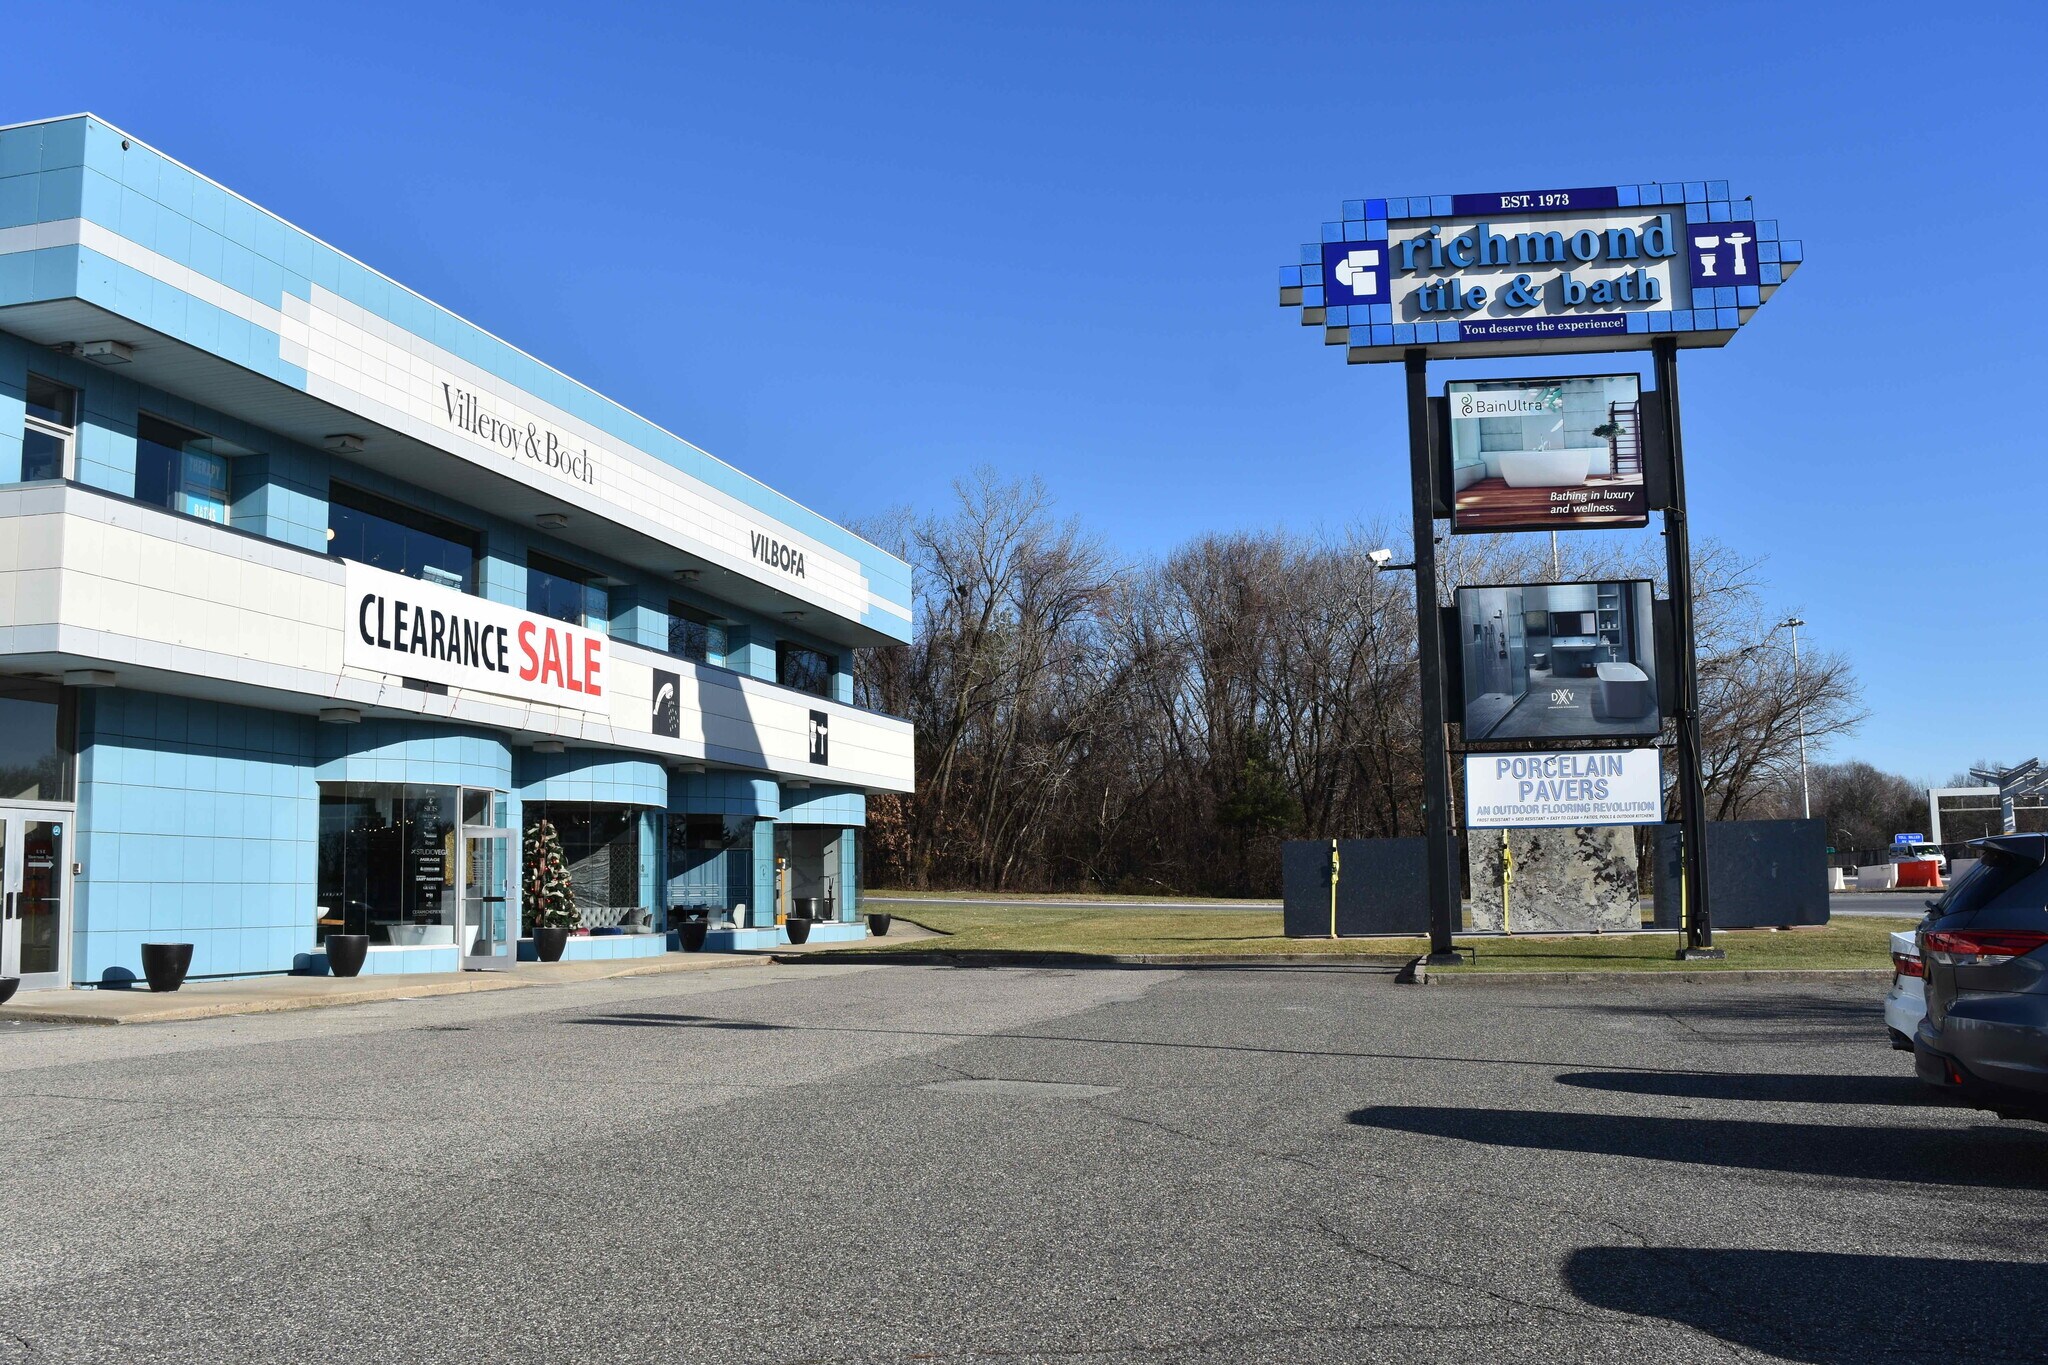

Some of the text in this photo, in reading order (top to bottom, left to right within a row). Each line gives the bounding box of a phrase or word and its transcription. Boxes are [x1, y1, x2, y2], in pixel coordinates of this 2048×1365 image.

[1500, 193, 1569, 208] EST. 1973
[1399, 213, 1677, 270] richmond
[1416, 269, 1662, 312] tile & bath
[1463, 318, 1624, 335] You deserve the experience!
[1476, 399, 1543, 413] BainUltra
[1550, 489, 1635, 503] Bathing in luxury
[1550, 502, 1617, 514] and wellness.
[750, 529, 805, 579] VILBOFA
[359, 593, 602, 697] CLEARANCE SALE
[1551, 688, 1575, 705] DXV
[1496, 754, 1624, 780] PORCELAIN
[1519, 778, 1609, 802] PAVERS
[1476, 801, 1655, 816] AN OUTDOOR FLOORING REVOLUTION
